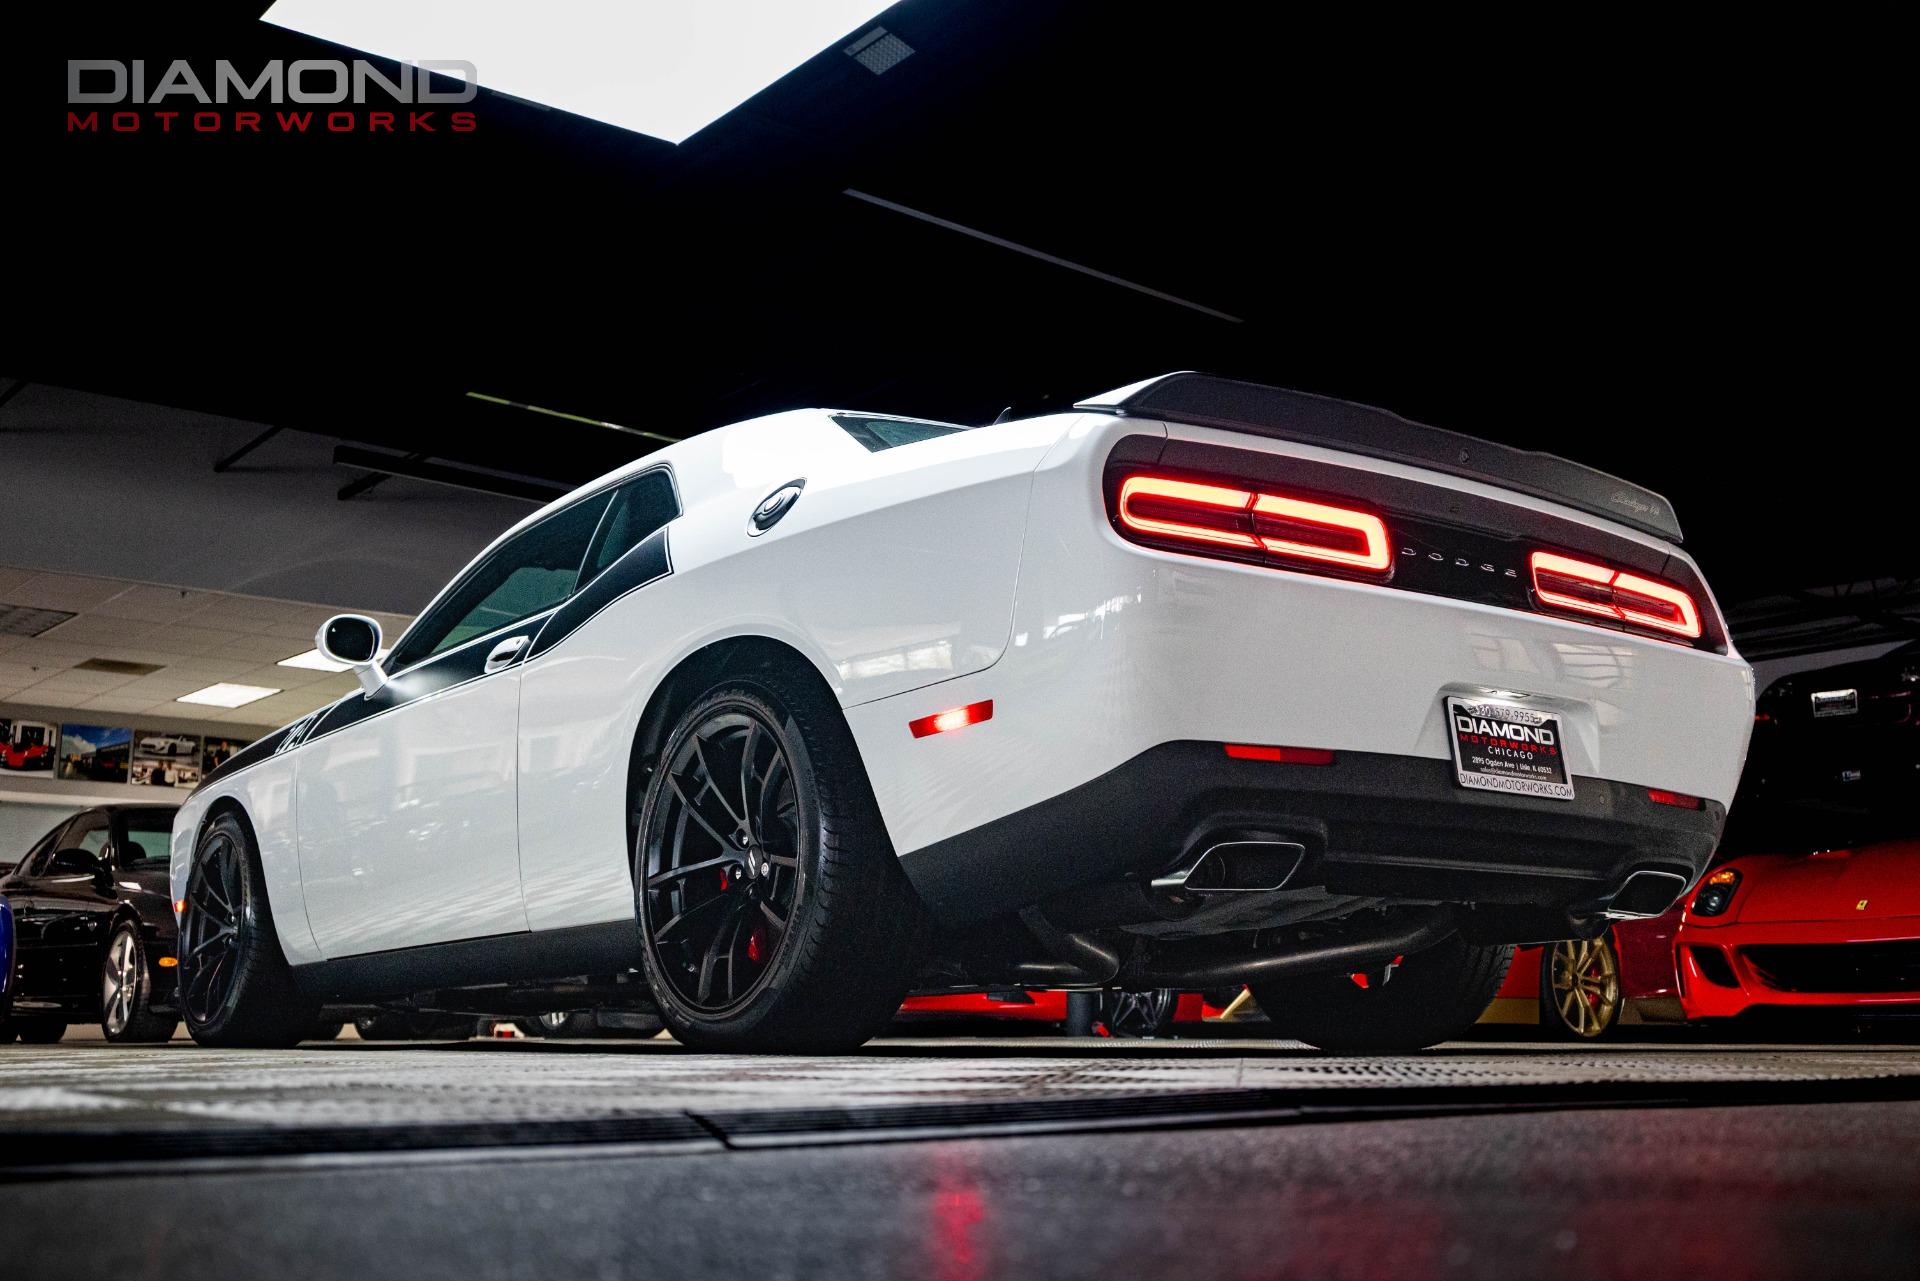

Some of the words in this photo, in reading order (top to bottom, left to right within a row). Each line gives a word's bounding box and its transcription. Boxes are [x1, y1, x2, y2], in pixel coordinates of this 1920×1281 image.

[1401, 547, 1518, 578] DODGE
[1455, 715, 1555, 745] DIAMOND
[1459, 734, 1558, 756] MOTORWORKS
[1487, 746, 1534, 760] CHICAGO
[1485, 758, 1503, 767] Ogden
[1504, 761, 1515, 769] Ave
[1460, 773, 1574, 797] DIAMONDMOTORWORKS.COM
